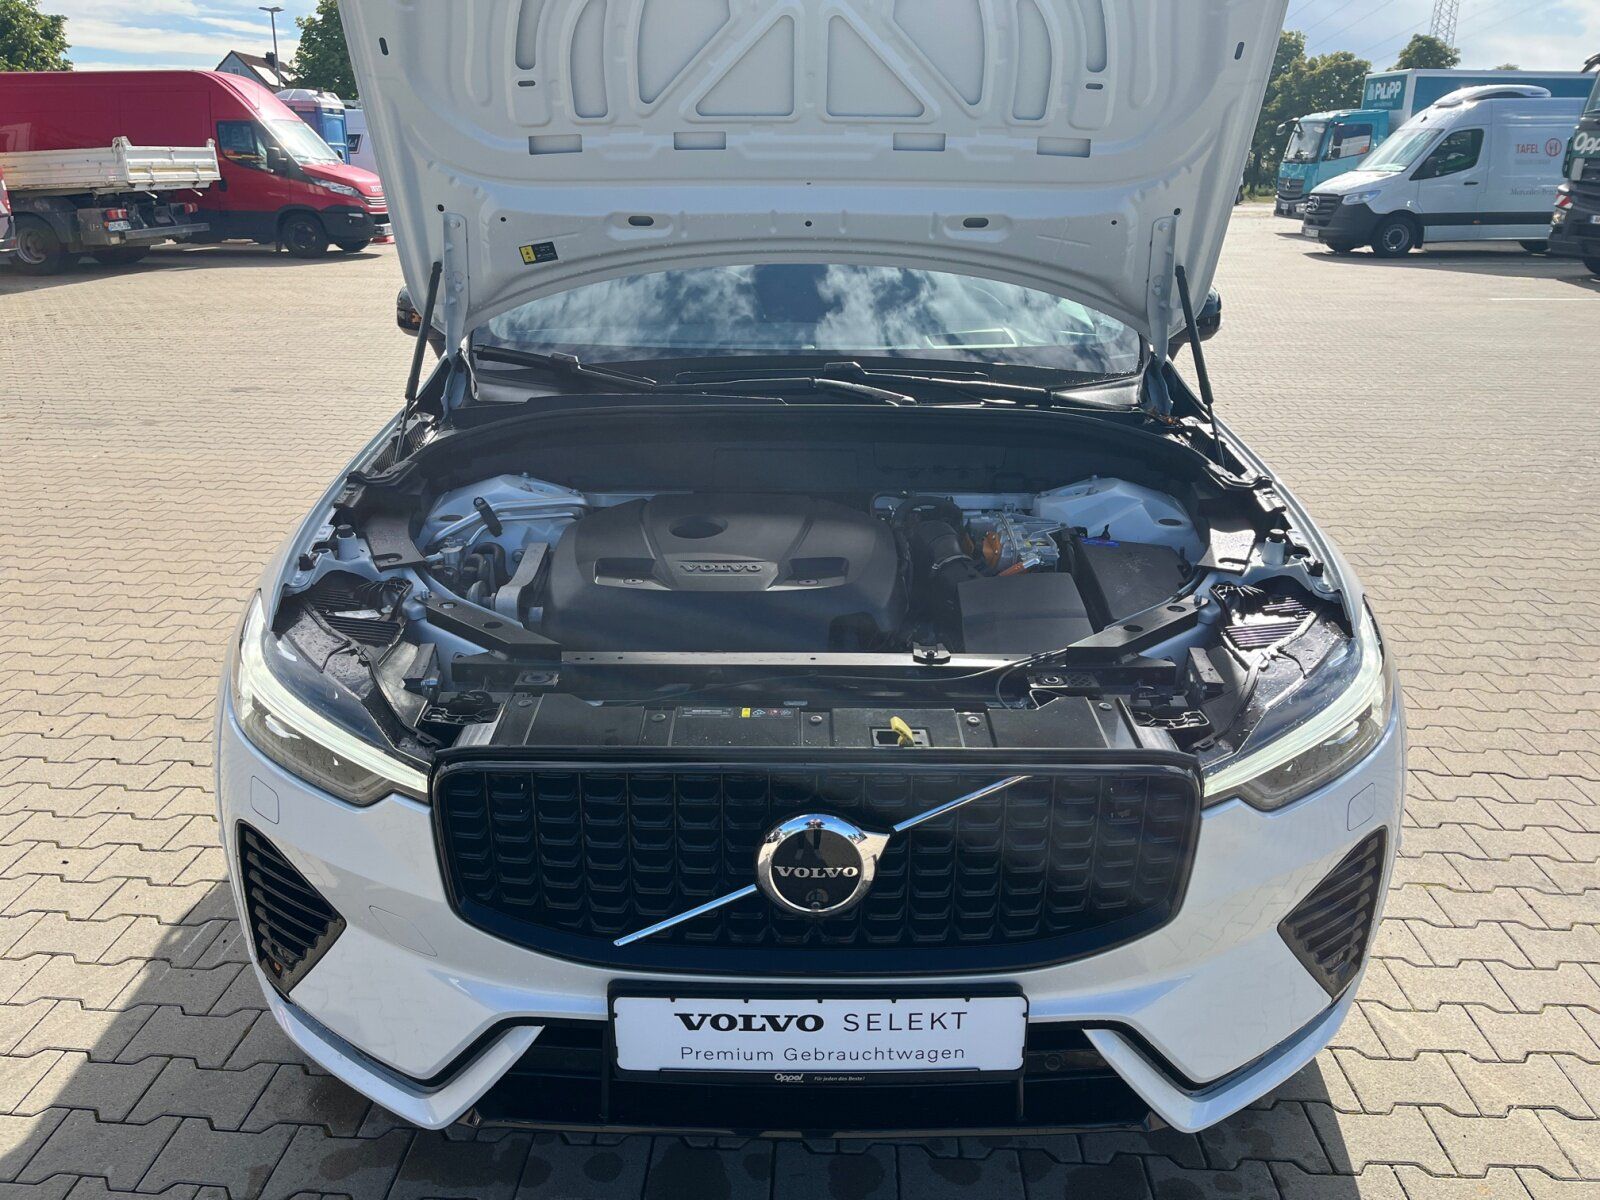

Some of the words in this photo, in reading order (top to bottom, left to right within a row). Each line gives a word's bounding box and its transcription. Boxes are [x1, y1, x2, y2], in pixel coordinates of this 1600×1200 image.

[1515, 143, 1539, 154] TAFEL
[681, 563, 762, 573] VOLVO
[775, 866, 858, 878] VOLVO
[674, 1013, 824, 1032] VOLVO
[843, 1011, 969, 1032] SELEKT
[680, 1046, 774, 1062] Premium
[783, 1045, 966, 1063] Gebrauchtwagen
[774, 1073, 804, 1083] Oppel
